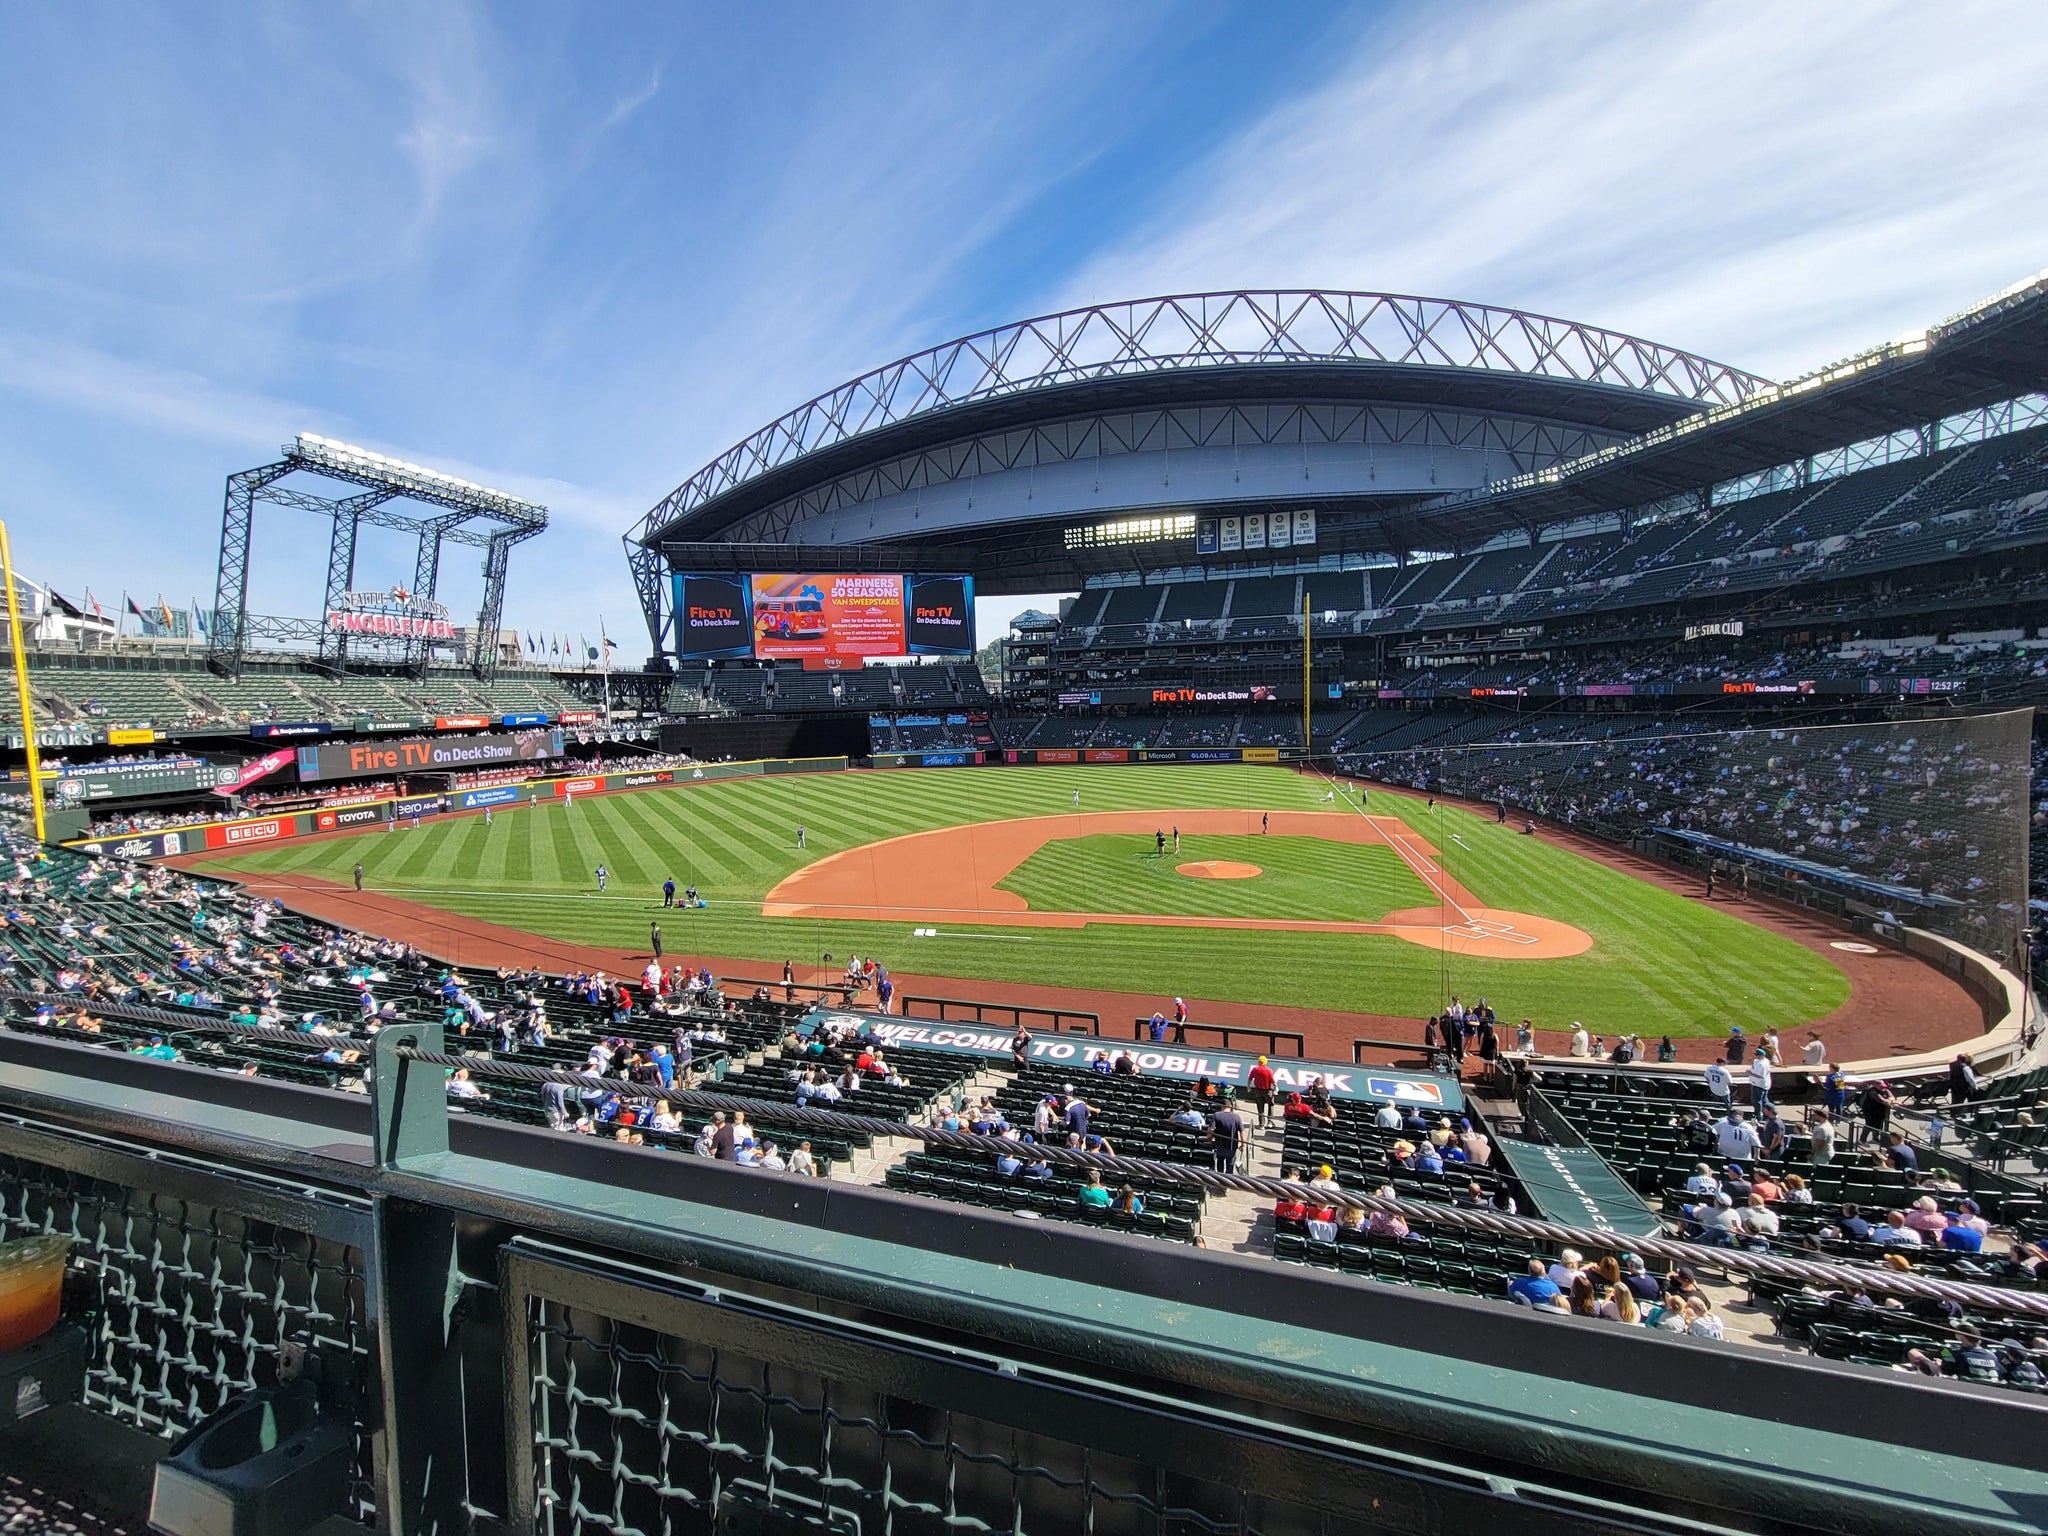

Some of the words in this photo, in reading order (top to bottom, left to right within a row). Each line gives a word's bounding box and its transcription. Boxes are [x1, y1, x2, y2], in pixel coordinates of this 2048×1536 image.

[835, 578, 894, 588] MARINERS
[831, 587, 845, 597] 50
[847, 587, 899, 597] SEASONS
[343, 591, 387, 608] SEATTLE
[849, 598, 899, 606] SWEEPSTAKES
[410, 595, 449, 618] MARINERS
[690, 606, 716, 618] Fire
[717, 608, 732, 618] TV
[916, 607, 935, 617] Fire
[937, 607, 952, 617] TV
[327, 610, 411, 636] T-MOBILE
[413, 619, 457, 639] PARK
[690, 619, 703, 627] On
[704, 619, 722, 627] Deck
[941, 617, 961, 625] Show
[1684, 624, 1720, 641] ALL-STAR
[1722, 621, 1743, 637] CLUB
[1471, 688, 1485, 696] Fire
[1485, 688, 1494, 696] TV
[1723, 683, 1742, 693] Fire
[1742, 683, 1755, 693] TV
[1931, 682, 1952, 691] 12:52
[1153, 690, 1176, 702] Fire
[1178, 689, 1195, 701] TV
[1196, 692, 1206, 700] On
[1207, 691, 1226, 700] Deck
[1227, 691, 1249, 700] Show
[154, 731, 166, 739] CAT
[351, 748, 398, 771] Fire
[400, 744, 431, 765] TV
[433, 747, 451, 763] On
[453, 746, 481, 761] Deck
[483, 743, 512, 759] Show
[925, 756, 953, 766] Alaska
[68, 768, 107, 777] HOME
[108, 766, 133, 774] RUN
[134, 763, 175, 773] PORCH
[625, 774, 657, 786] KeyBank
[568, 782, 593, 790] Nintendo
[324, 795, 376, 807] NORTHWEST
[398, 803, 422, 815] eero
[338, 810, 375, 822] TOYOTA
[231, 824, 276, 839] BECU
[114, 840, 153, 858] Miller
[1032, 1040, 1076, 1059] TO
[1248, 1066, 1355, 1092] ARK
[1711, 1074, 1720, 1084] 13
[600, 1110, 607, 1120] 5
[638, 1114, 645, 1125] 6
[1692, 1131, 1709, 1146] 29
[1733, 1130, 1742, 1141] 11
